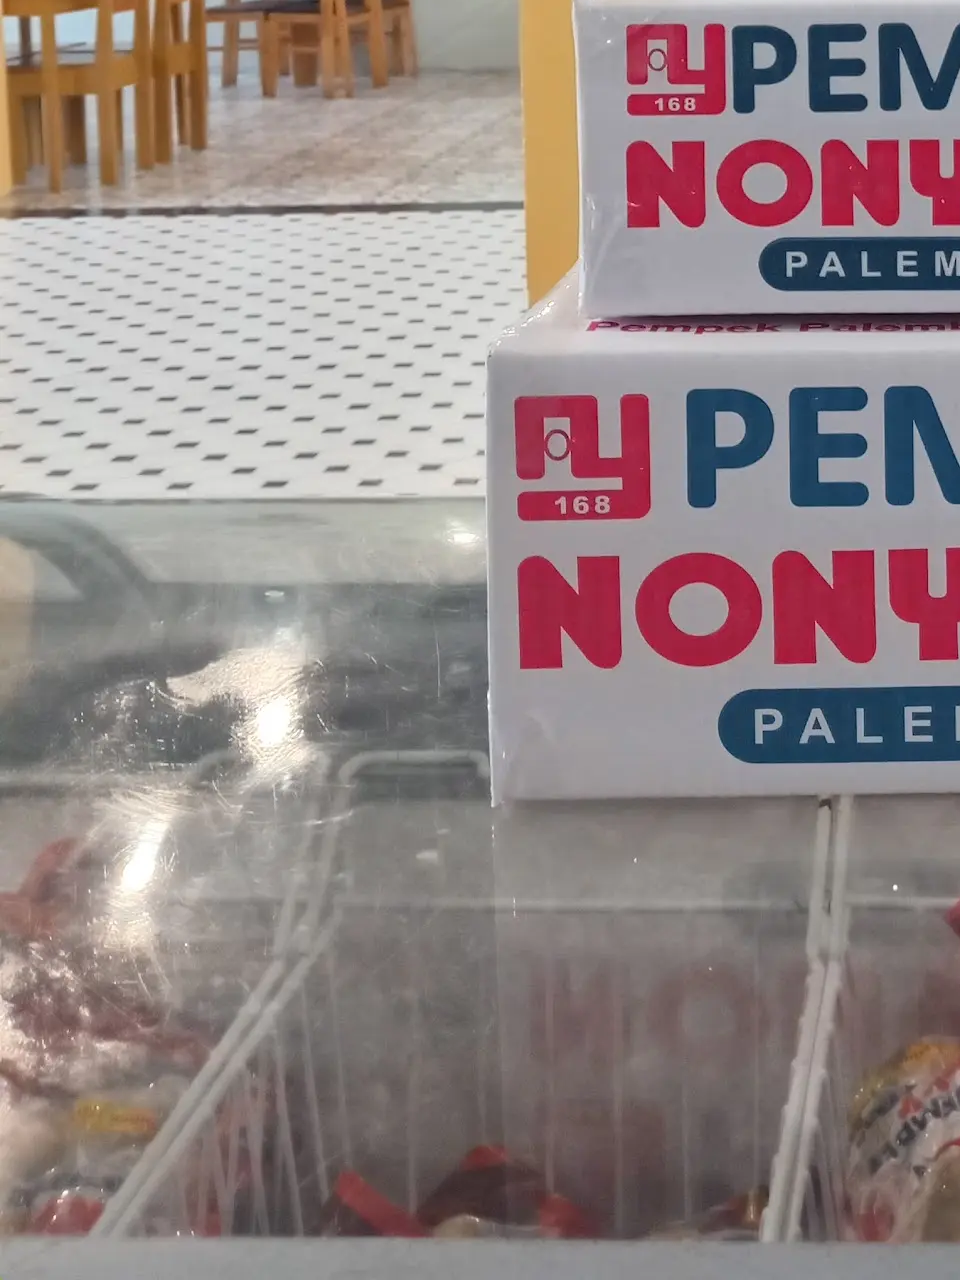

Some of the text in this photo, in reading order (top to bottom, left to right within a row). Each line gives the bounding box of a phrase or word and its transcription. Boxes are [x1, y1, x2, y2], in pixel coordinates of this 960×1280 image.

[653, 96, 697, 111] 168
[585, 320, 783, 336] Pempek
[554, 495, 610, 515] 168
